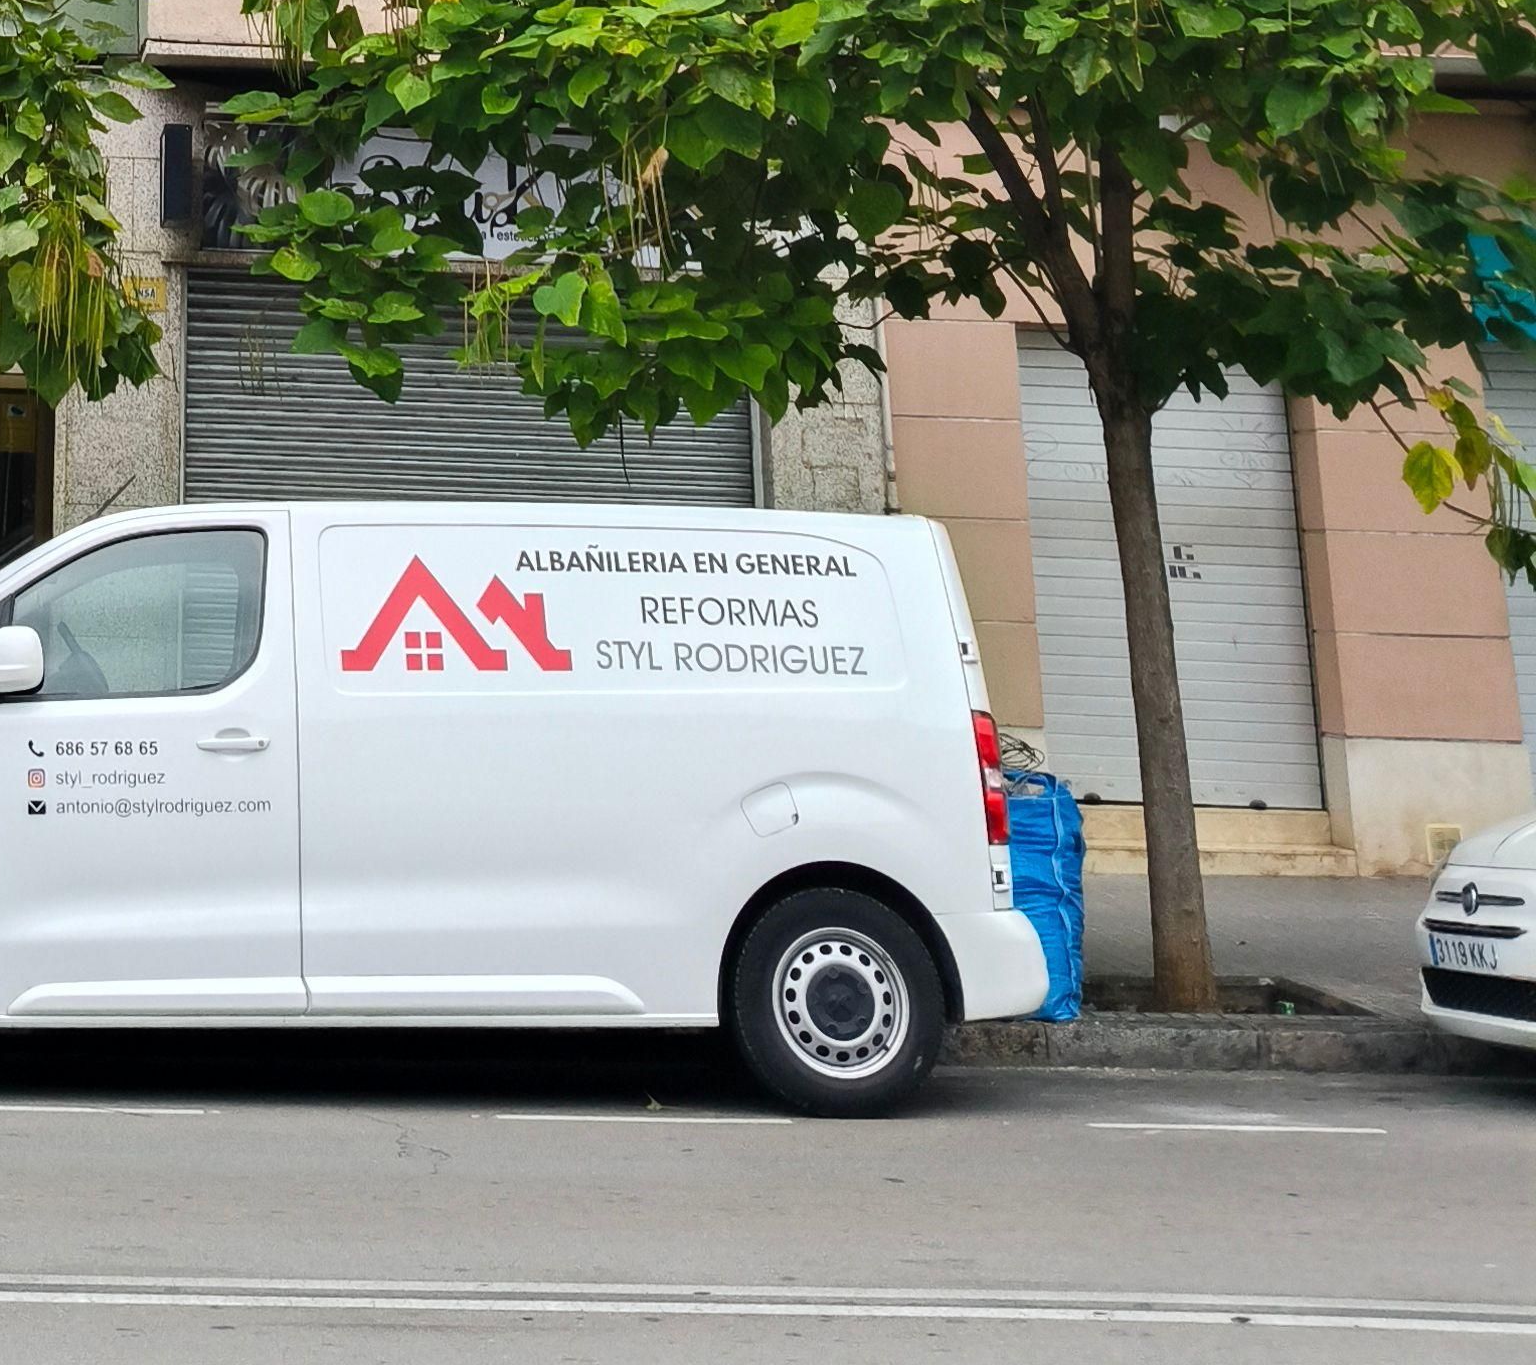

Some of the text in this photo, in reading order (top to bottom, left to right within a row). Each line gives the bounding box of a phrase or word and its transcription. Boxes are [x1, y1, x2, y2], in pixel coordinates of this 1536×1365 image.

[516, 545, 857, 577] ALBAÑILERIA EN GENERAL
[641, 596, 819, 628] REFORMAS
[596, 640, 868, 676] STYL RODRIGUEZ
[55, 741, 158, 756] 686 57 68 65
[55, 771, 166, 788] styl_rodriguez
[56, 798, 271, 817] antonio@stylrodriguez.com
